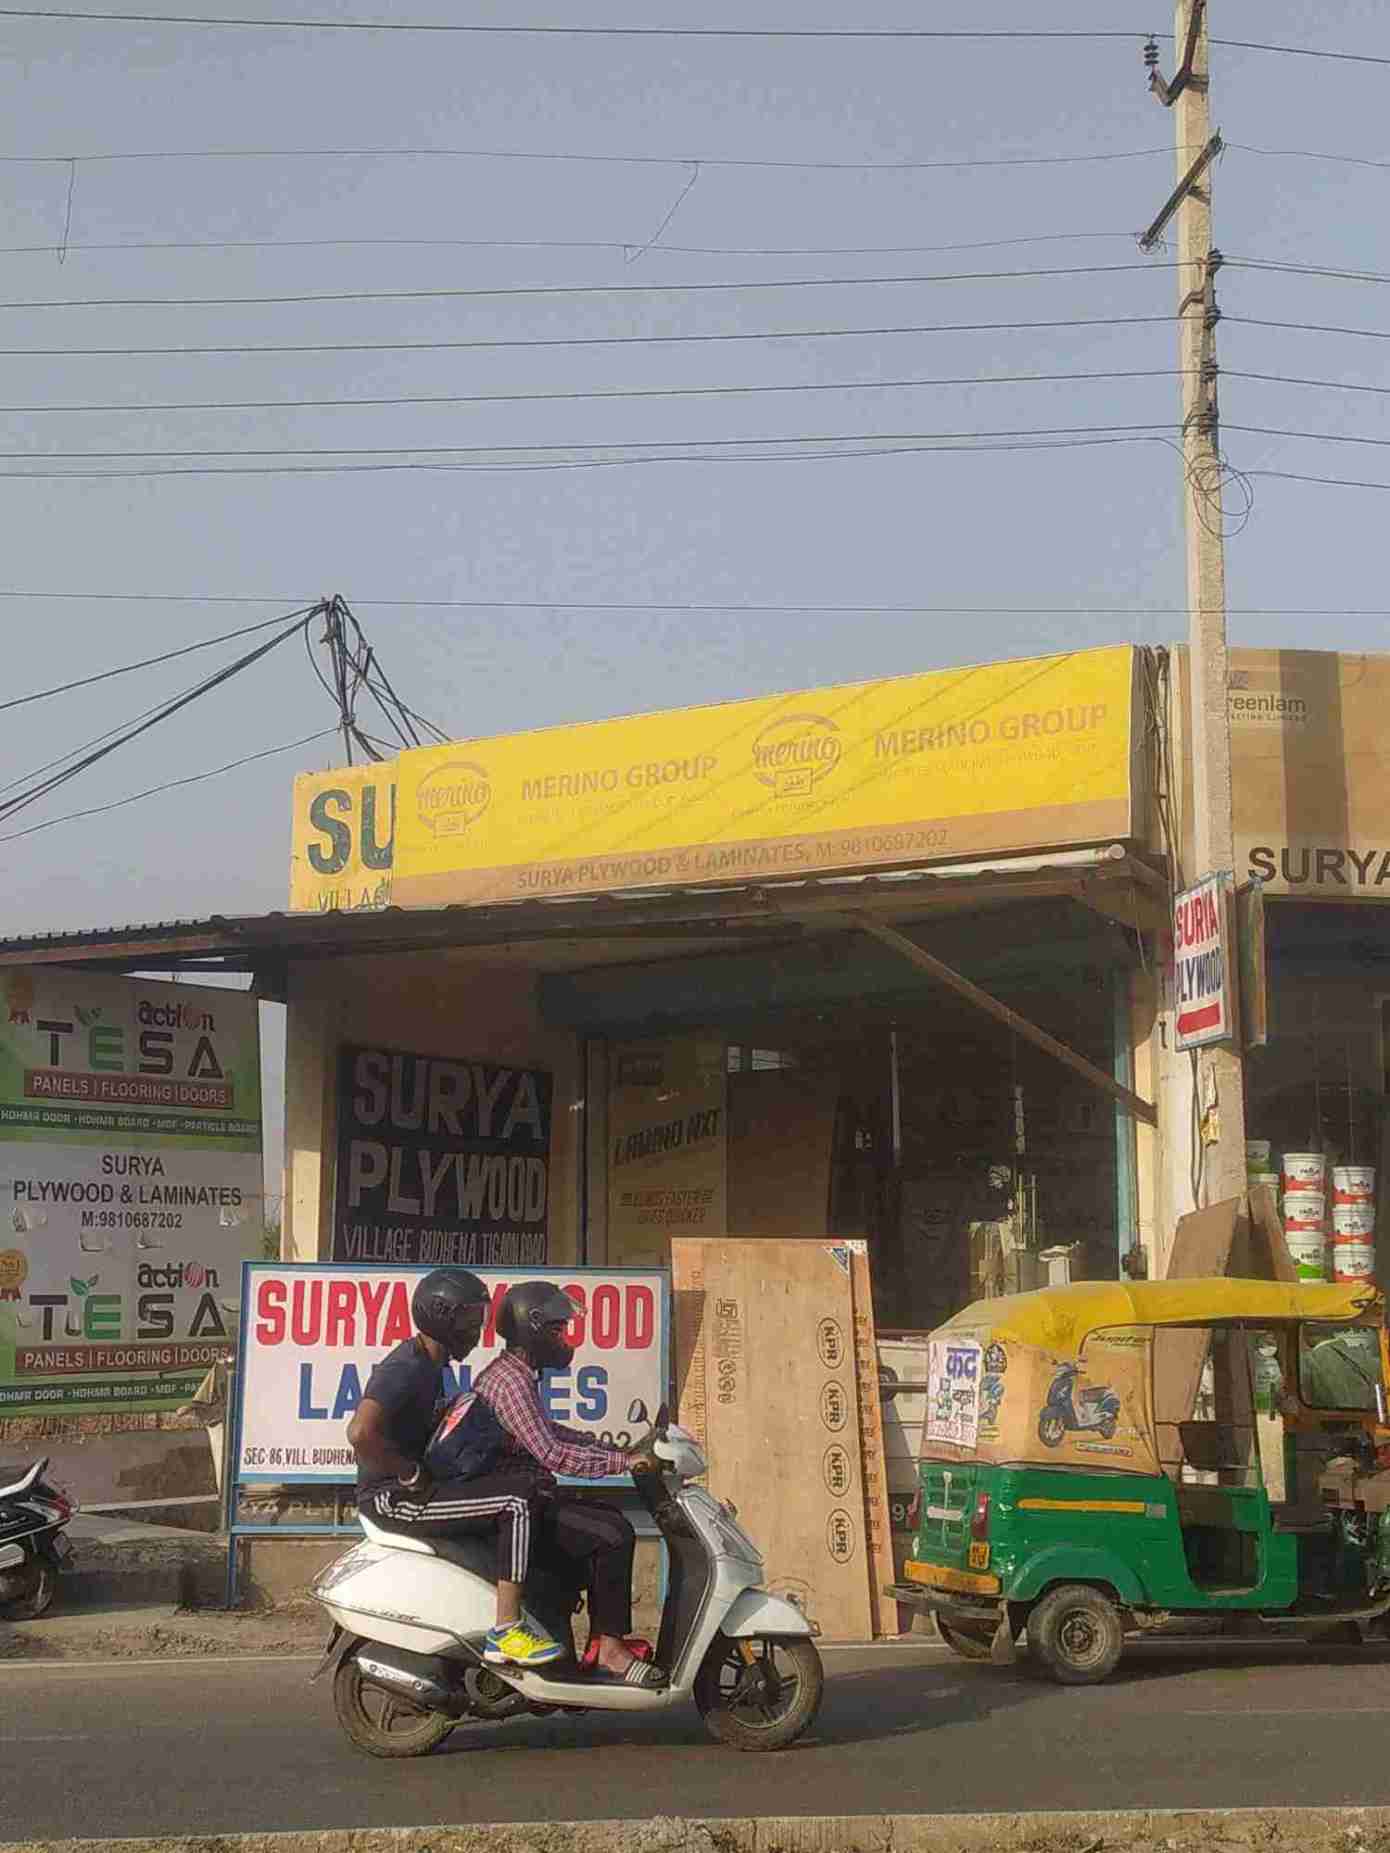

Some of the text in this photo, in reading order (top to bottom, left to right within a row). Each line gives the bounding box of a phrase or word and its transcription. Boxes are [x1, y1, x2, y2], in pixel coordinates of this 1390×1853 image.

[874, 703, 1107, 758] MERINO GROUP
[521, 753, 718, 800] MERINO GROUP
[517, 864, 576, 889] SURYA
[577, 856, 672, 883] PLYWOOD
[138, 1000, 216, 1032] action
[36, 1019, 224, 1079] TESA
[32, 1076, 225, 1104] PANELS FLOORING DOORS
[352, 1051, 546, 1140] SURYA
[101, 1154, 165, 1177] SURYA
[347, 1140, 547, 1223] PLYWOOD
[13, 1180, 242, 1207] PLYWOOD & LAMINATES
[81, 1211, 183, 1229] M:9810687202
[343, 1223, 417, 1262] VILLAGE
[137, 1262, 220, 1289] action
[29, 1292, 227, 1340] TESA
[256, 1279, 412, 1346] SURYA
[24, 1352, 84, 1369] PANELS
[97, 1349, 171, 1367] FLOORING
